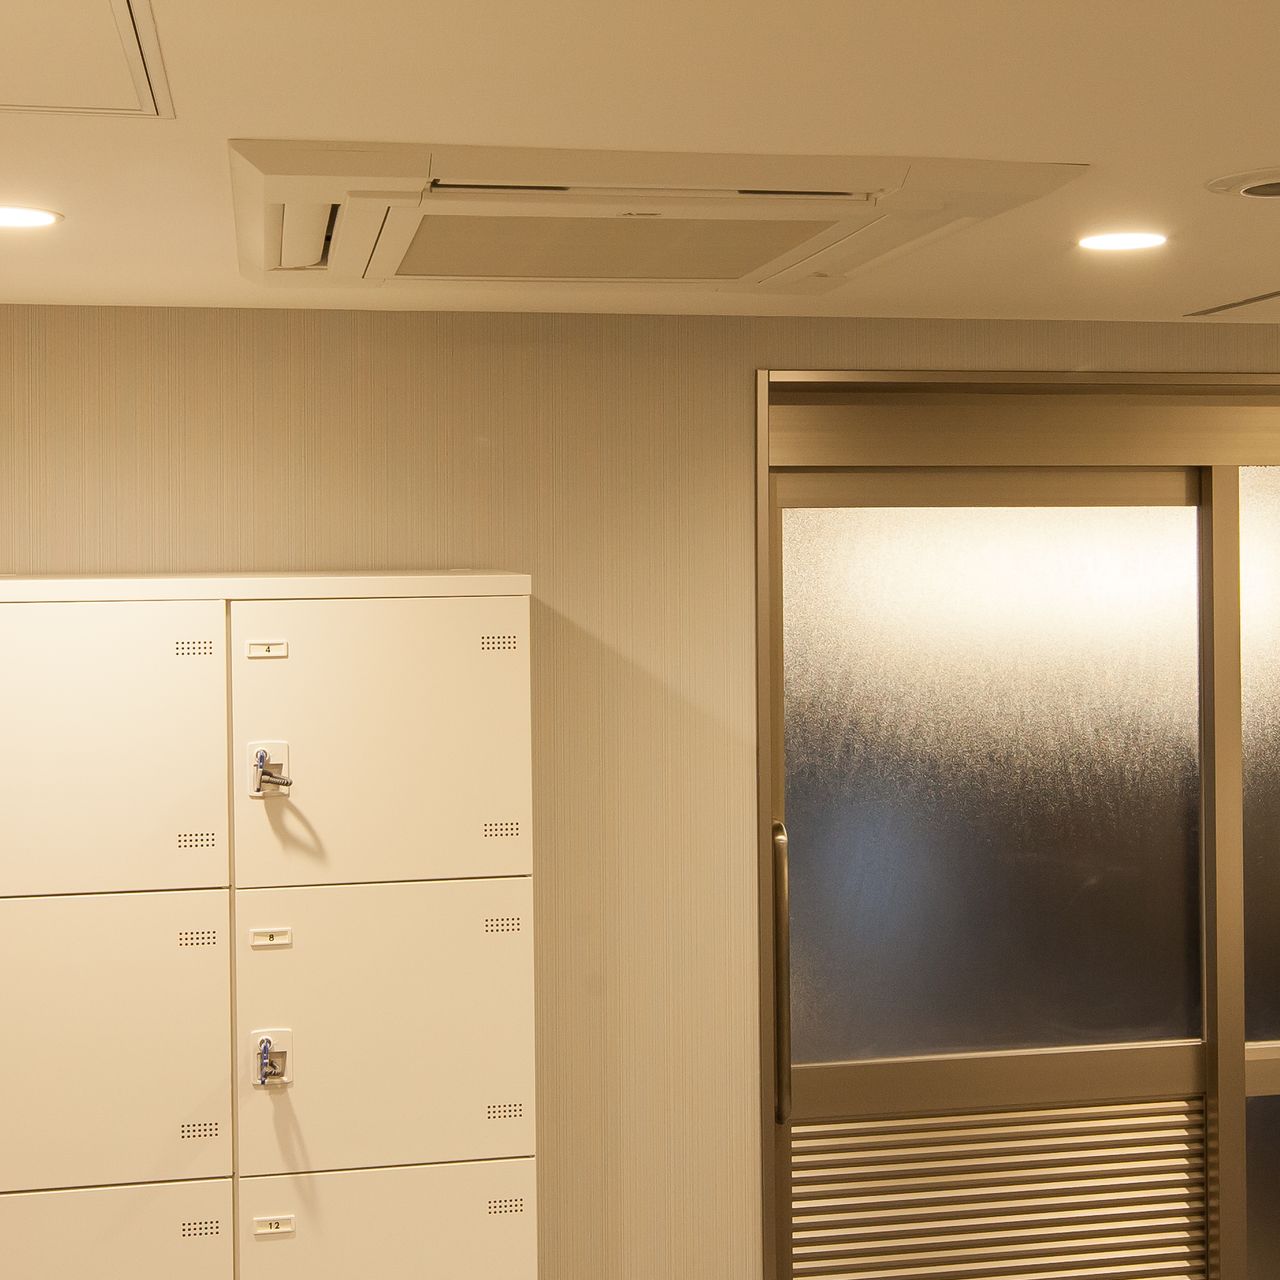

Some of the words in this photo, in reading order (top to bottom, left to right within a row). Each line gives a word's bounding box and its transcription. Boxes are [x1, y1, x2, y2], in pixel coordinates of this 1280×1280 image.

[265, 646, 271, 654] 4
[268, 934, 275, 942] 8
[268, 1221, 280, 1230] 12
